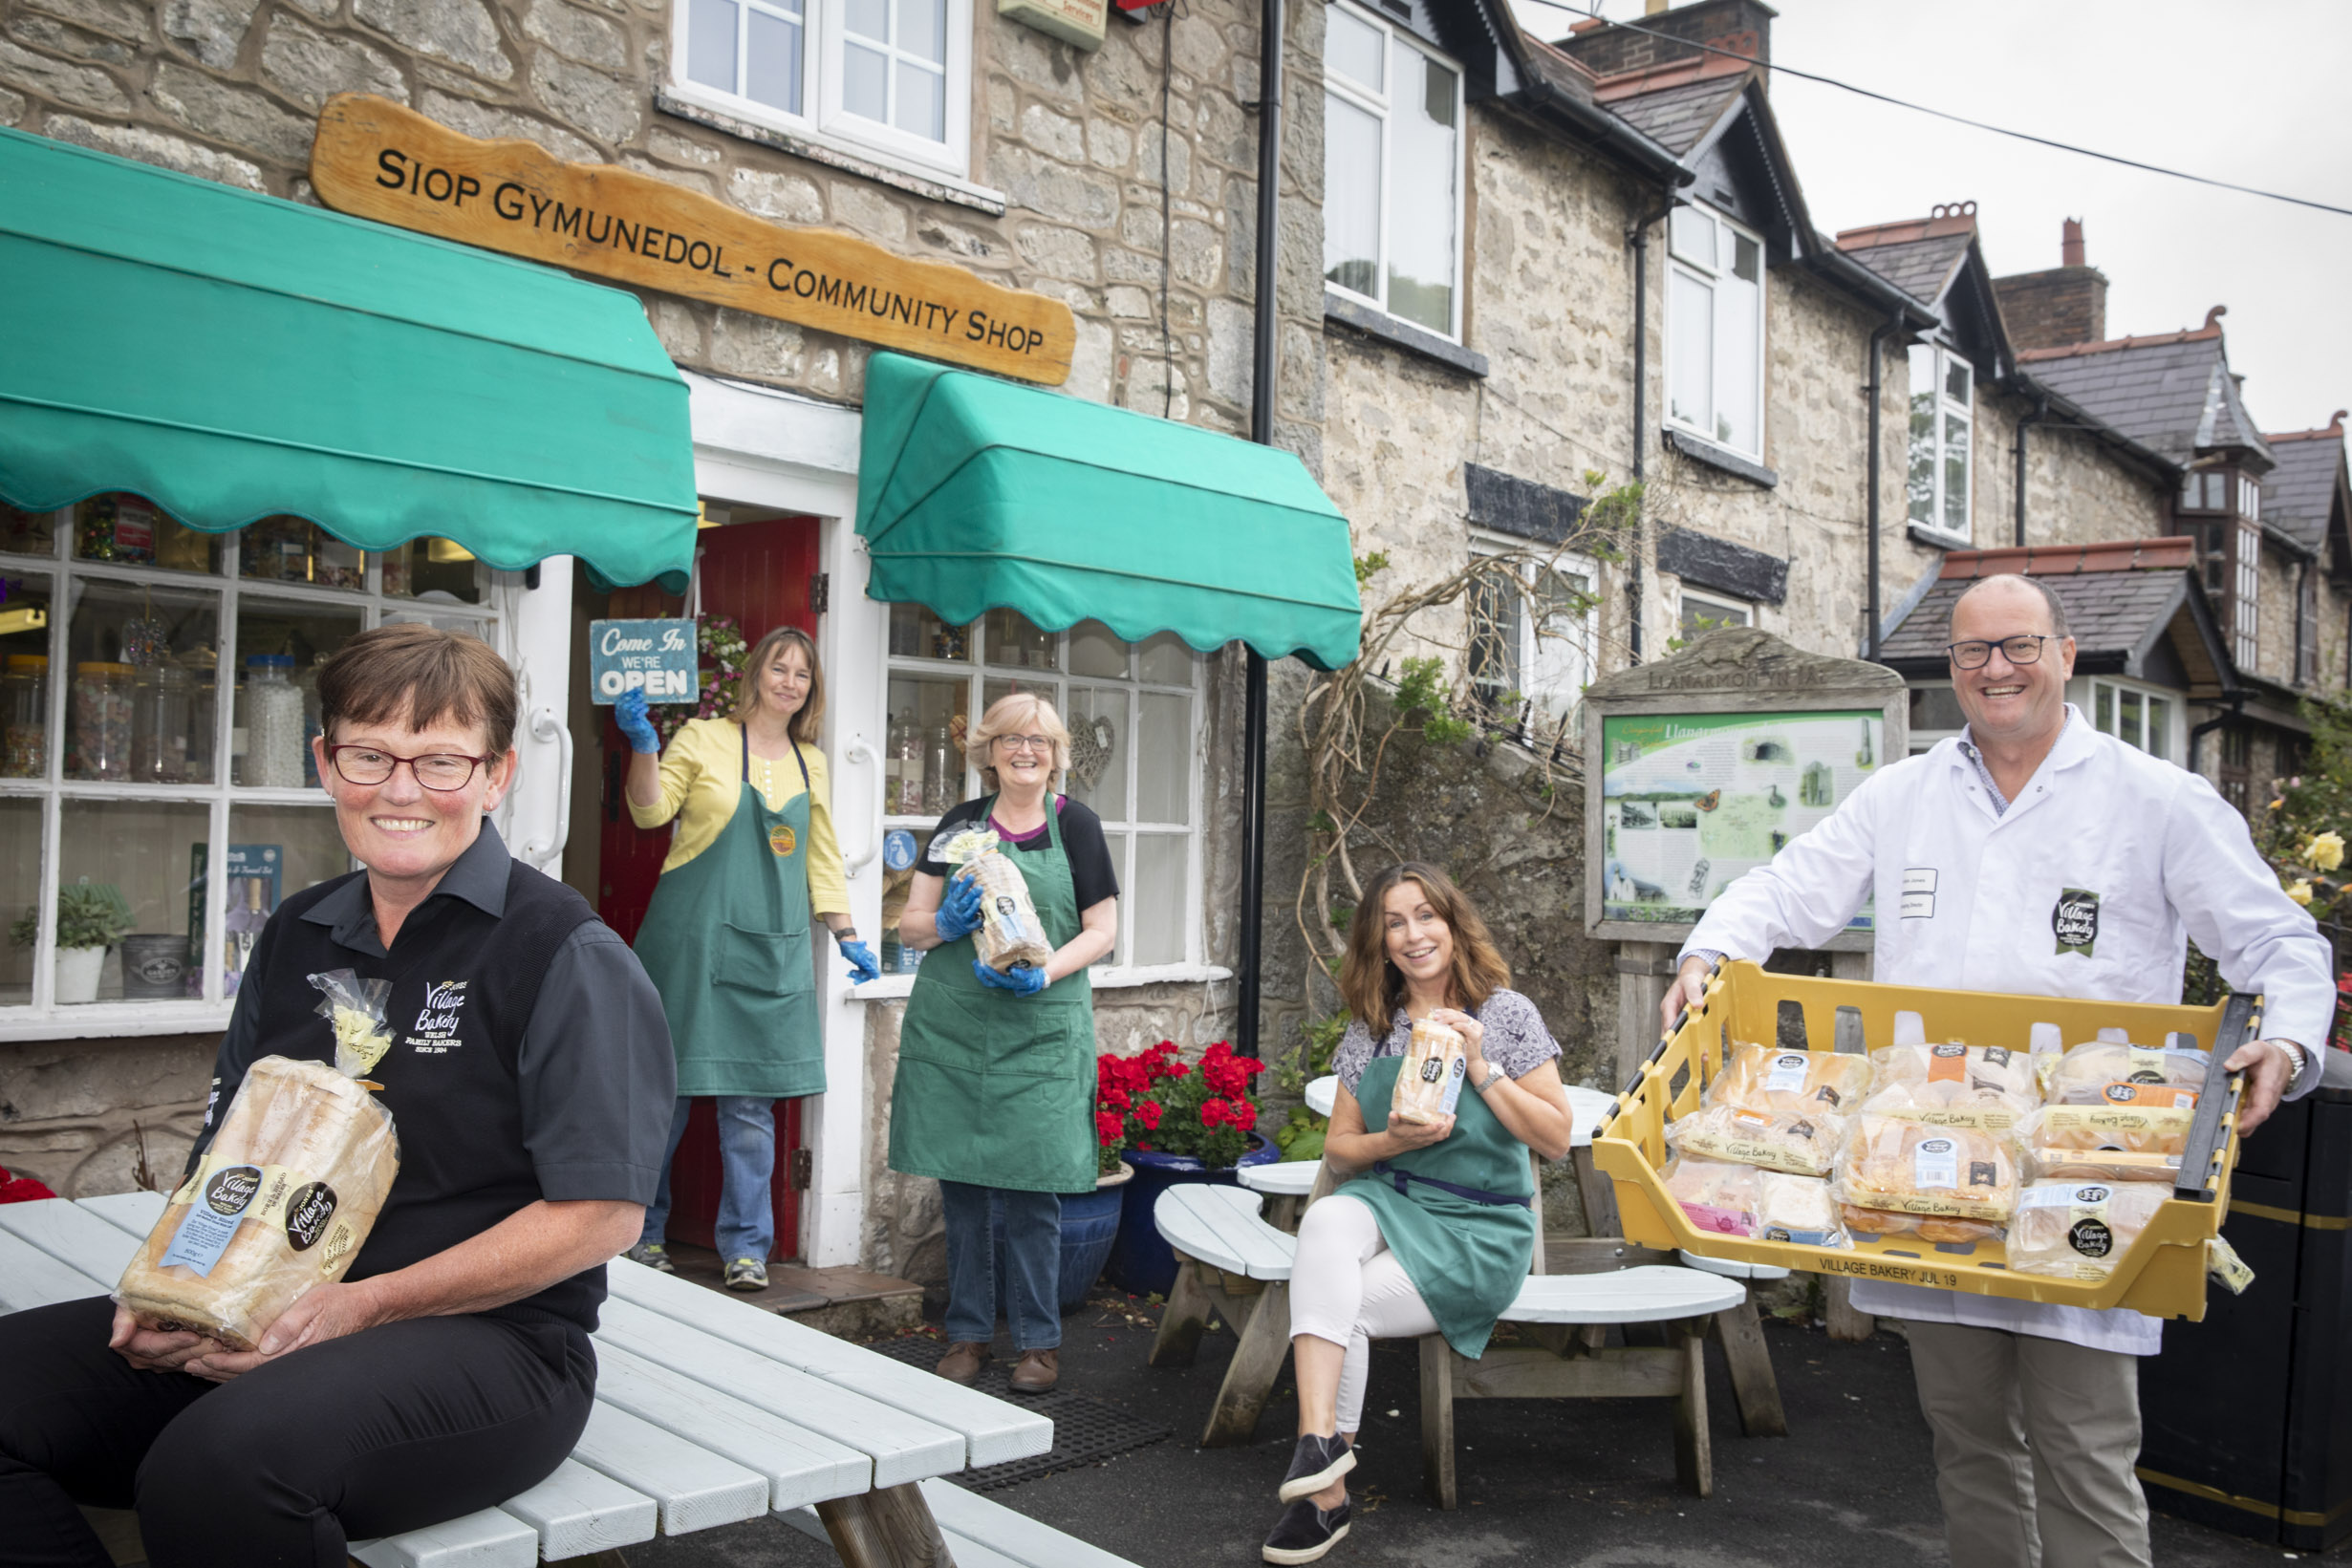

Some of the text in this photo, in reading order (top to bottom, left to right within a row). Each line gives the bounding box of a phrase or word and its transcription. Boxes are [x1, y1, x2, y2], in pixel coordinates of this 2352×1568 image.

[376, 148, 482, 209] SIOP
[493, 182, 734, 280] GYMUNEDOL
[766, 258, 959, 336] COMMUNITY
[965, 311, 1045, 356] SHOP
[600, 628, 687, 656] Come In
[622, 656, 661, 669] WE'RE
[599, 670, 688, 697] OPEN
[1649, 671, 1759, 690] LLANARMON
[2058, 901, 2095, 926] Village
[2057, 918, 2094, 939] Bakery
[426, 981, 464, 1018] Village
[415, 1009, 460, 1037] Bakery
[1919, 1111, 1948, 1126] Village
[1949, 1114, 1975, 1126] Bakery
[1725, 1142, 1751, 1161] Village
[1753, 1146, 1777, 1161] Bakery
[223, 1171, 256, 1198] Village
[211, 1186, 248, 1210] Bakery
[1902, 1200, 1931, 1215] Village
[1933, 1202, 1960, 1215] Bakery
[289, 1191, 324, 1234] Village
[301, 1201, 333, 1244] Bakery
[2072, 1227, 2108, 1245] Village
[2077, 1238, 2107, 1253] Bakery
[1819, 1257, 1957, 1286] VILLAGE BAKERY JUL 19
